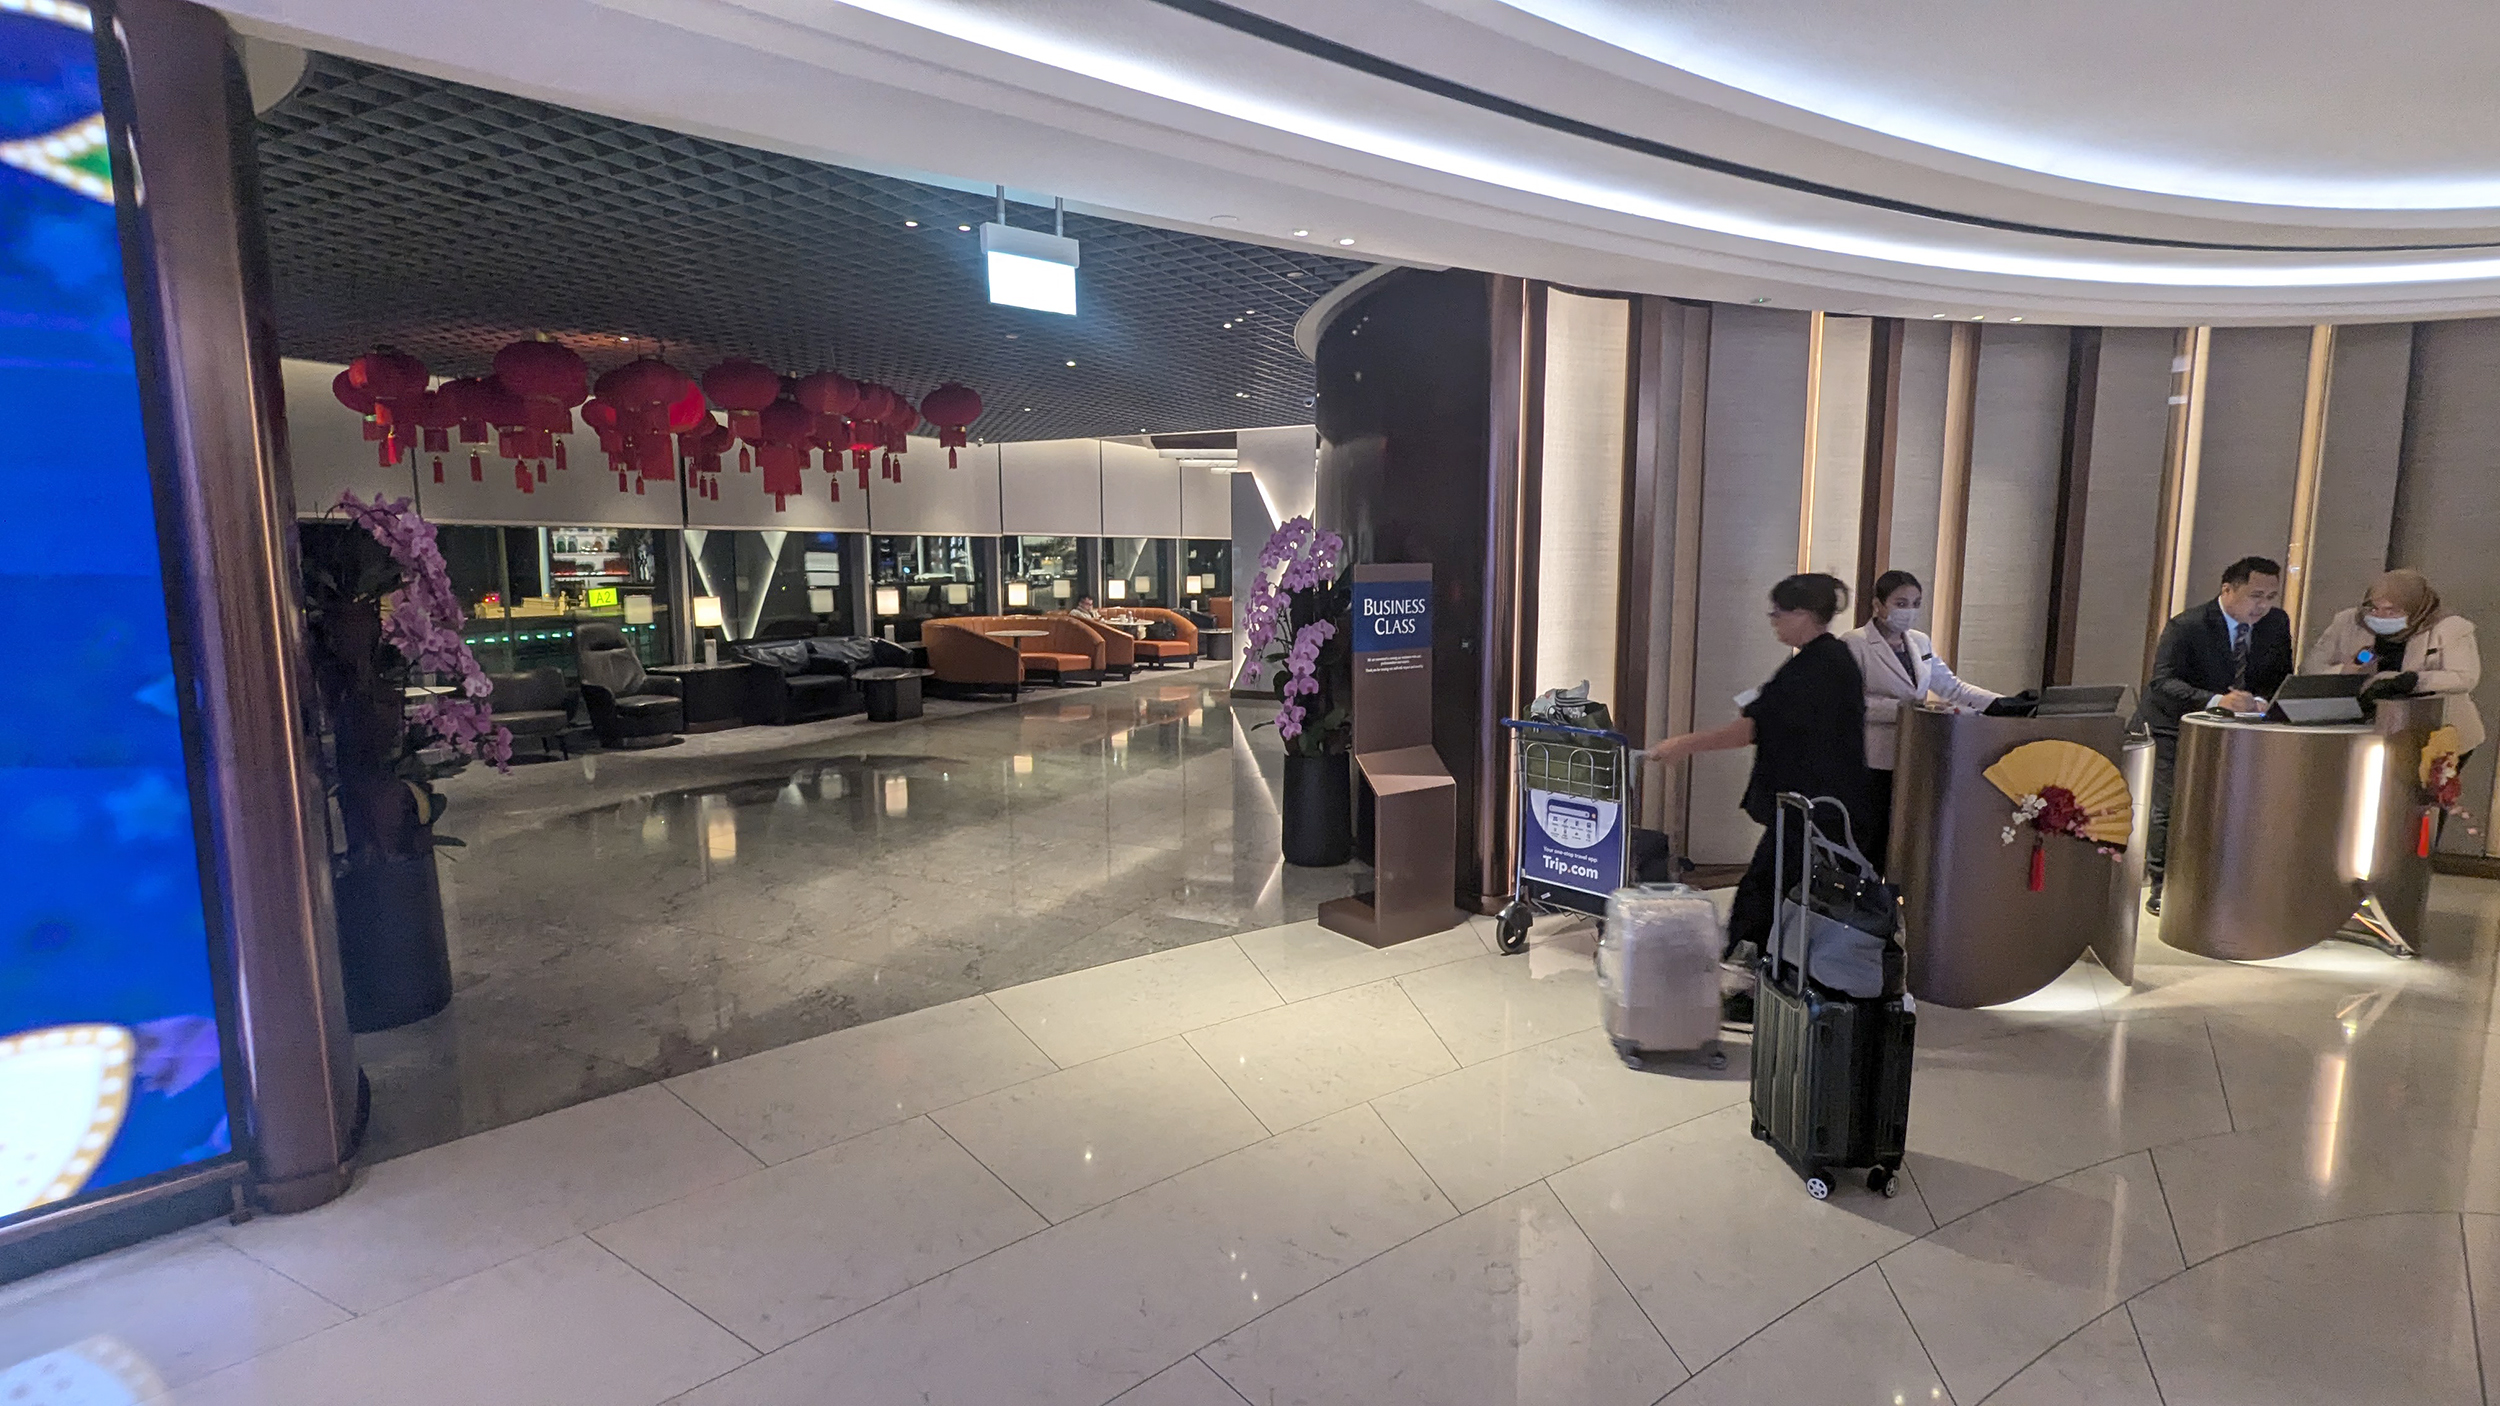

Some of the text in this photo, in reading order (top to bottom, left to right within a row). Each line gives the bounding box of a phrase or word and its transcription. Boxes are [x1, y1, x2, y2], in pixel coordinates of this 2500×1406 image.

[596, 591, 612, 604] A2
[1363, 598, 1426, 616] BUSINESS
[1374, 618, 1416, 635] CLASS
[1542, 854, 1599, 880] Trip.com
